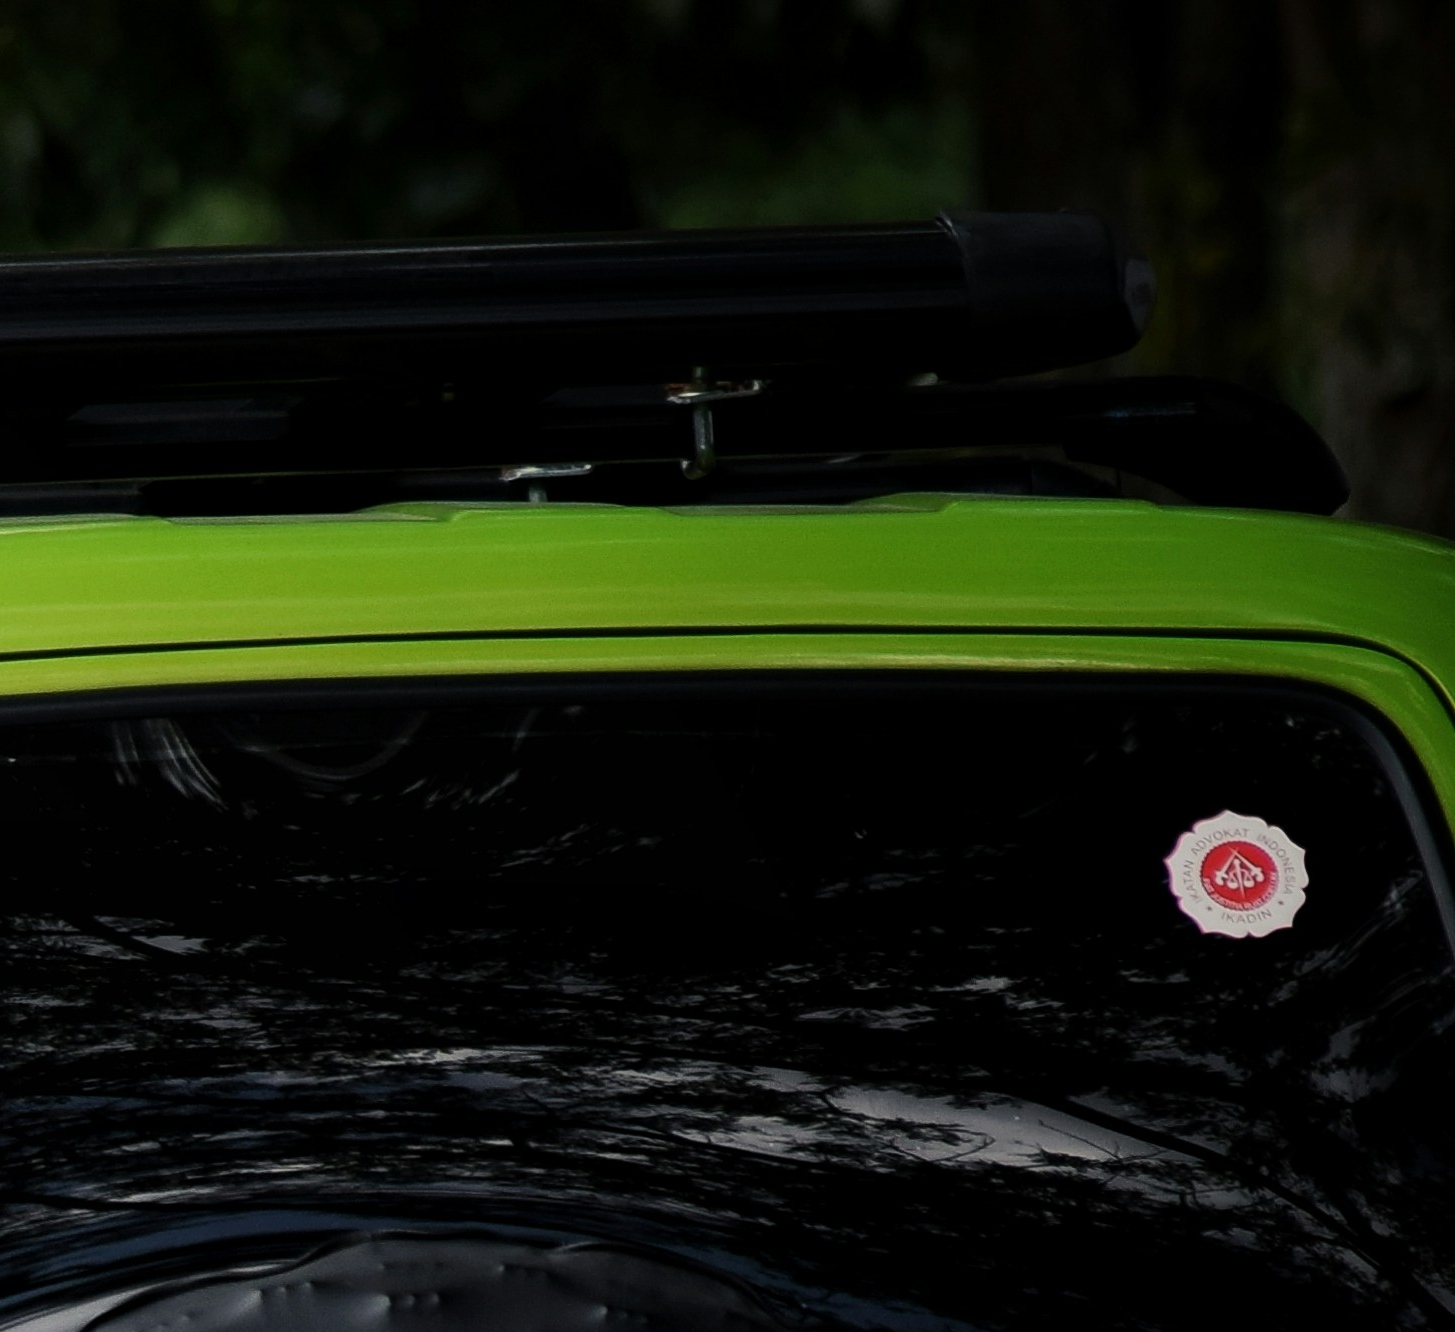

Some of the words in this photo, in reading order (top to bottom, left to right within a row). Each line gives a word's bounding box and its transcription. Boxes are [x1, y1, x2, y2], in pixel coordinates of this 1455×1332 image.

[1191, 828, 1250, 856] ADVOKAT
[1256, 833, 1297, 895] INDONESIA
[1220, 909, 1273, 924] IKADIN
